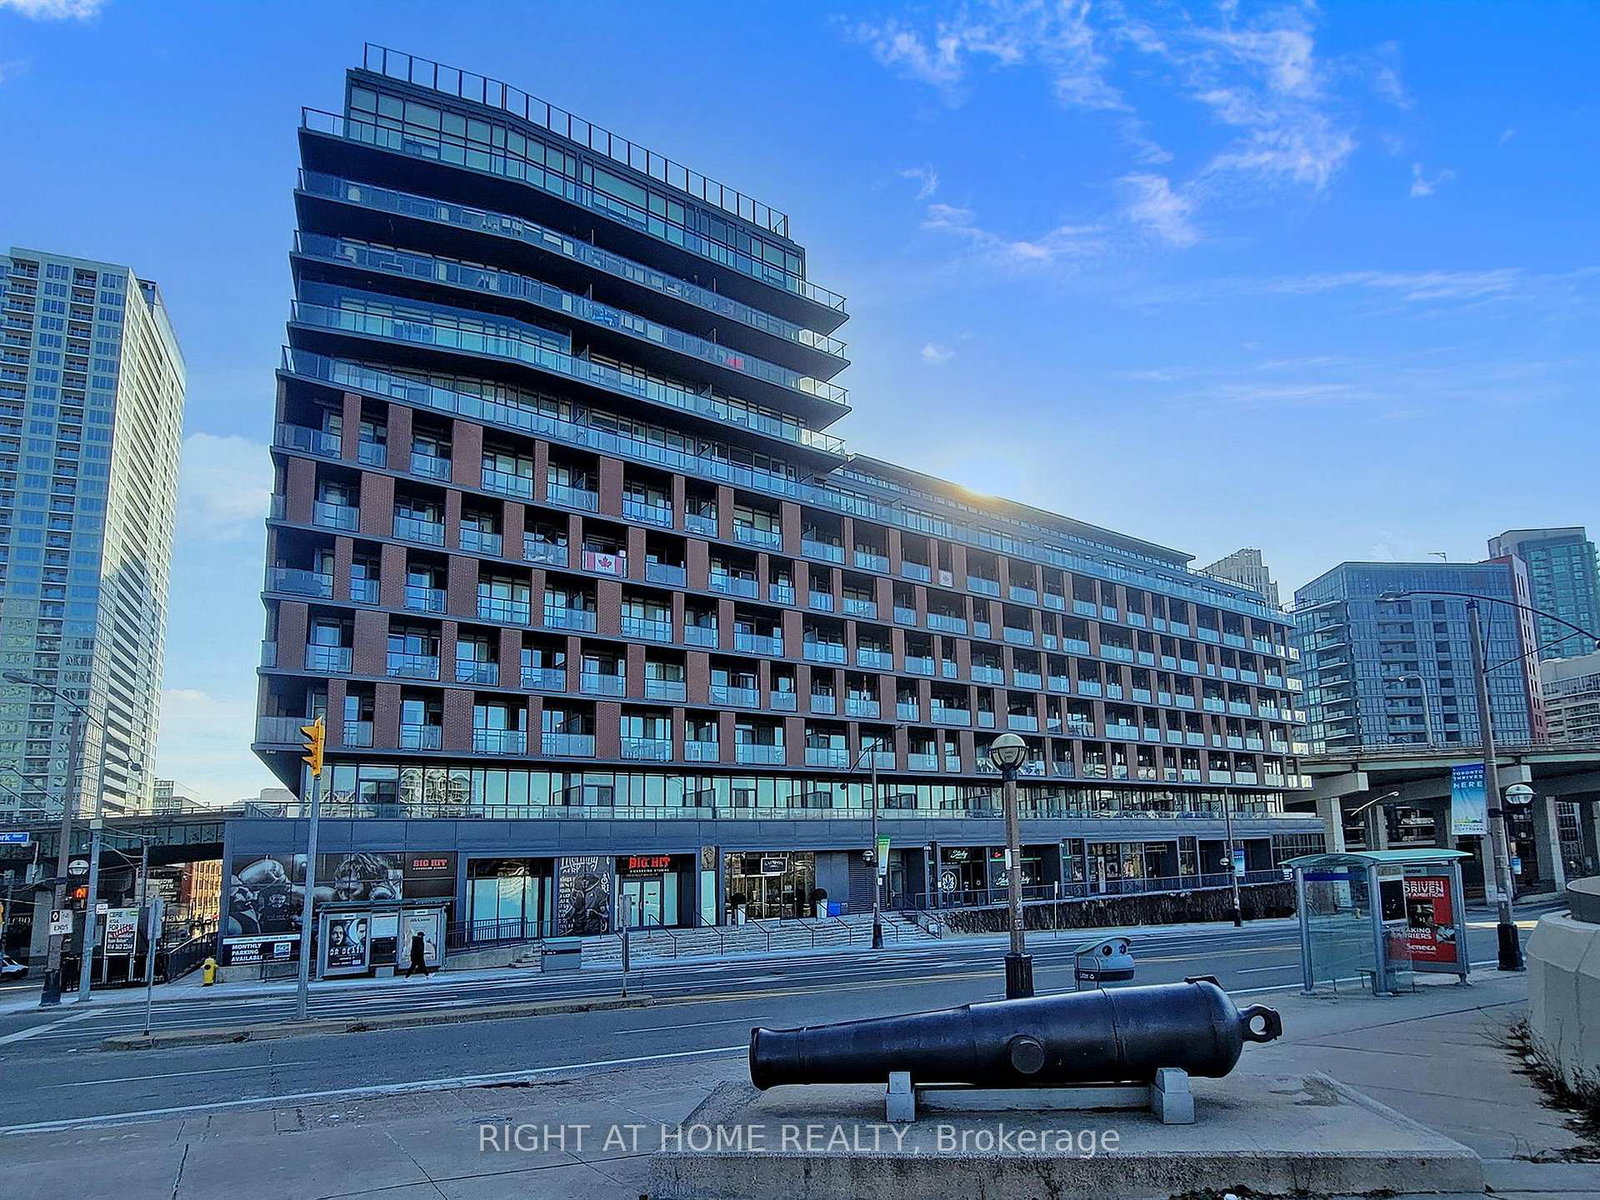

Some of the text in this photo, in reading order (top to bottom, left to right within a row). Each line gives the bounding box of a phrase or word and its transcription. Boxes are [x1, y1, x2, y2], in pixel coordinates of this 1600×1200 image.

[1453, 781, 1483, 789] HERE
[629, 856, 670, 869] BIG HIT
[1404, 885, 1443, 893] DRIVEN
[1407, 943, 1437, 951] Seneca
